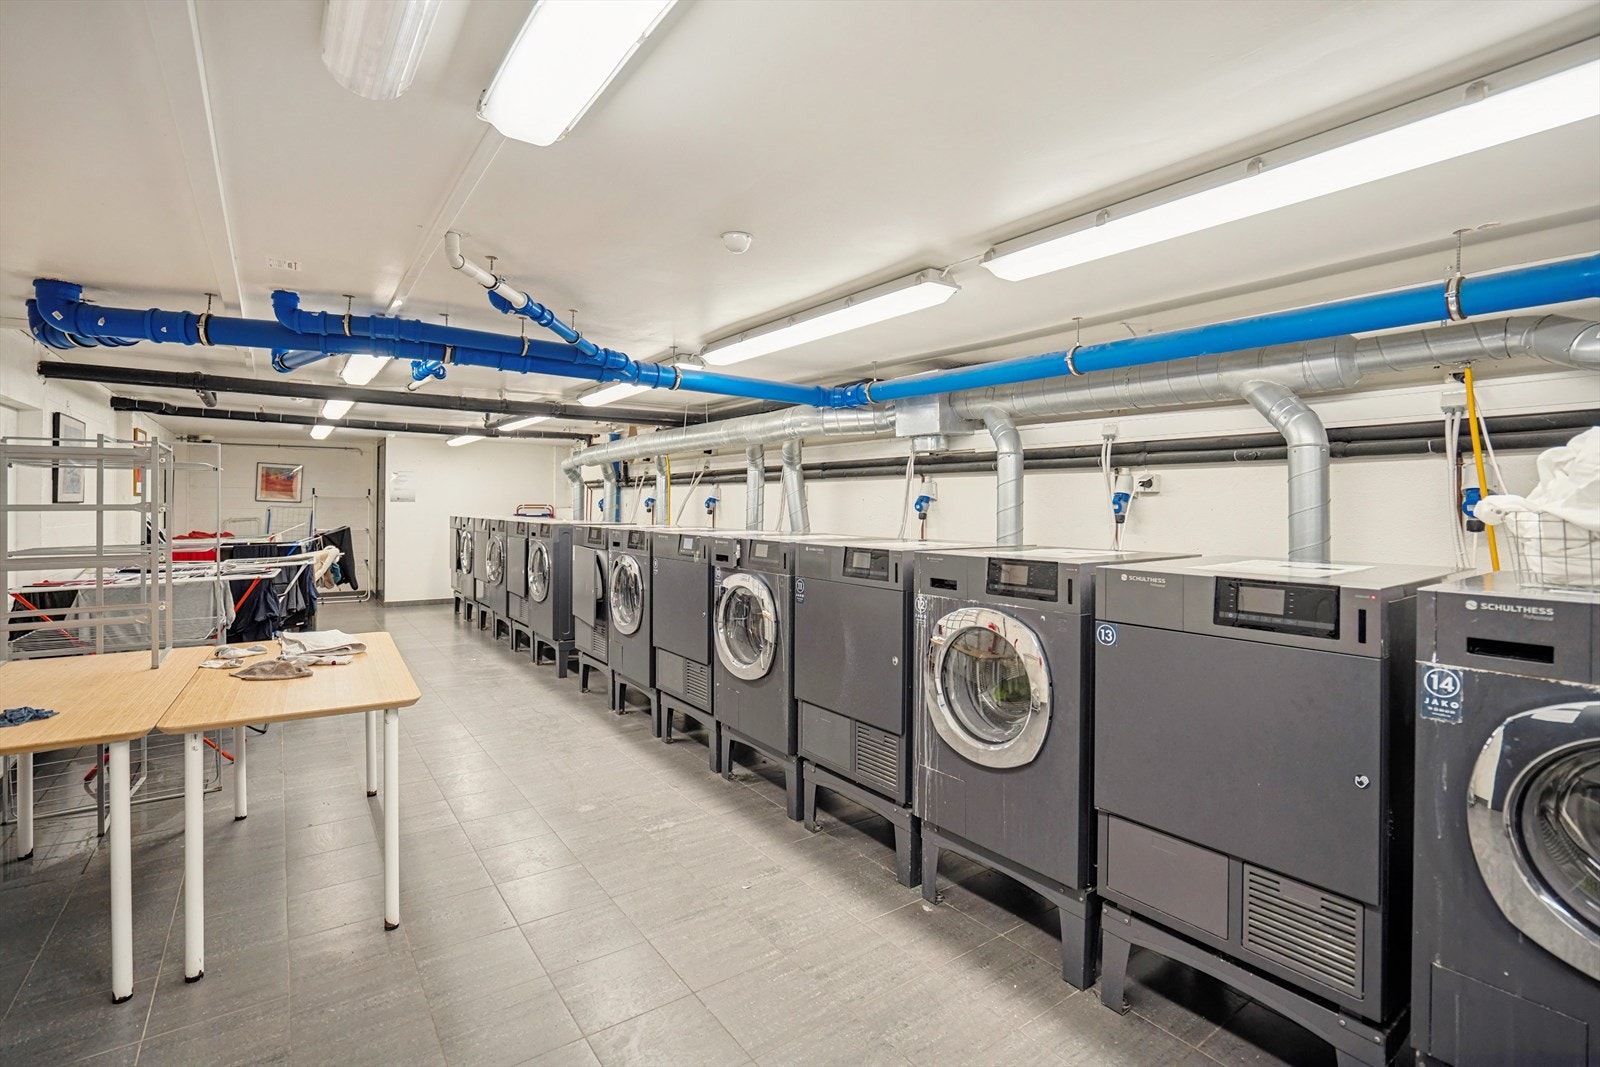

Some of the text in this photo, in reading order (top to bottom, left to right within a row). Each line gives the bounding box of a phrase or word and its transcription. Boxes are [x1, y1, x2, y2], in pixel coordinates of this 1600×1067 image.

[1480, 603, 1554, 615] SCHULTHESS
[1100, 629, 1113, 642] 13
[1430, 674, 1455, 692] 14
[1424, 697, 1459, 709] JAKO
